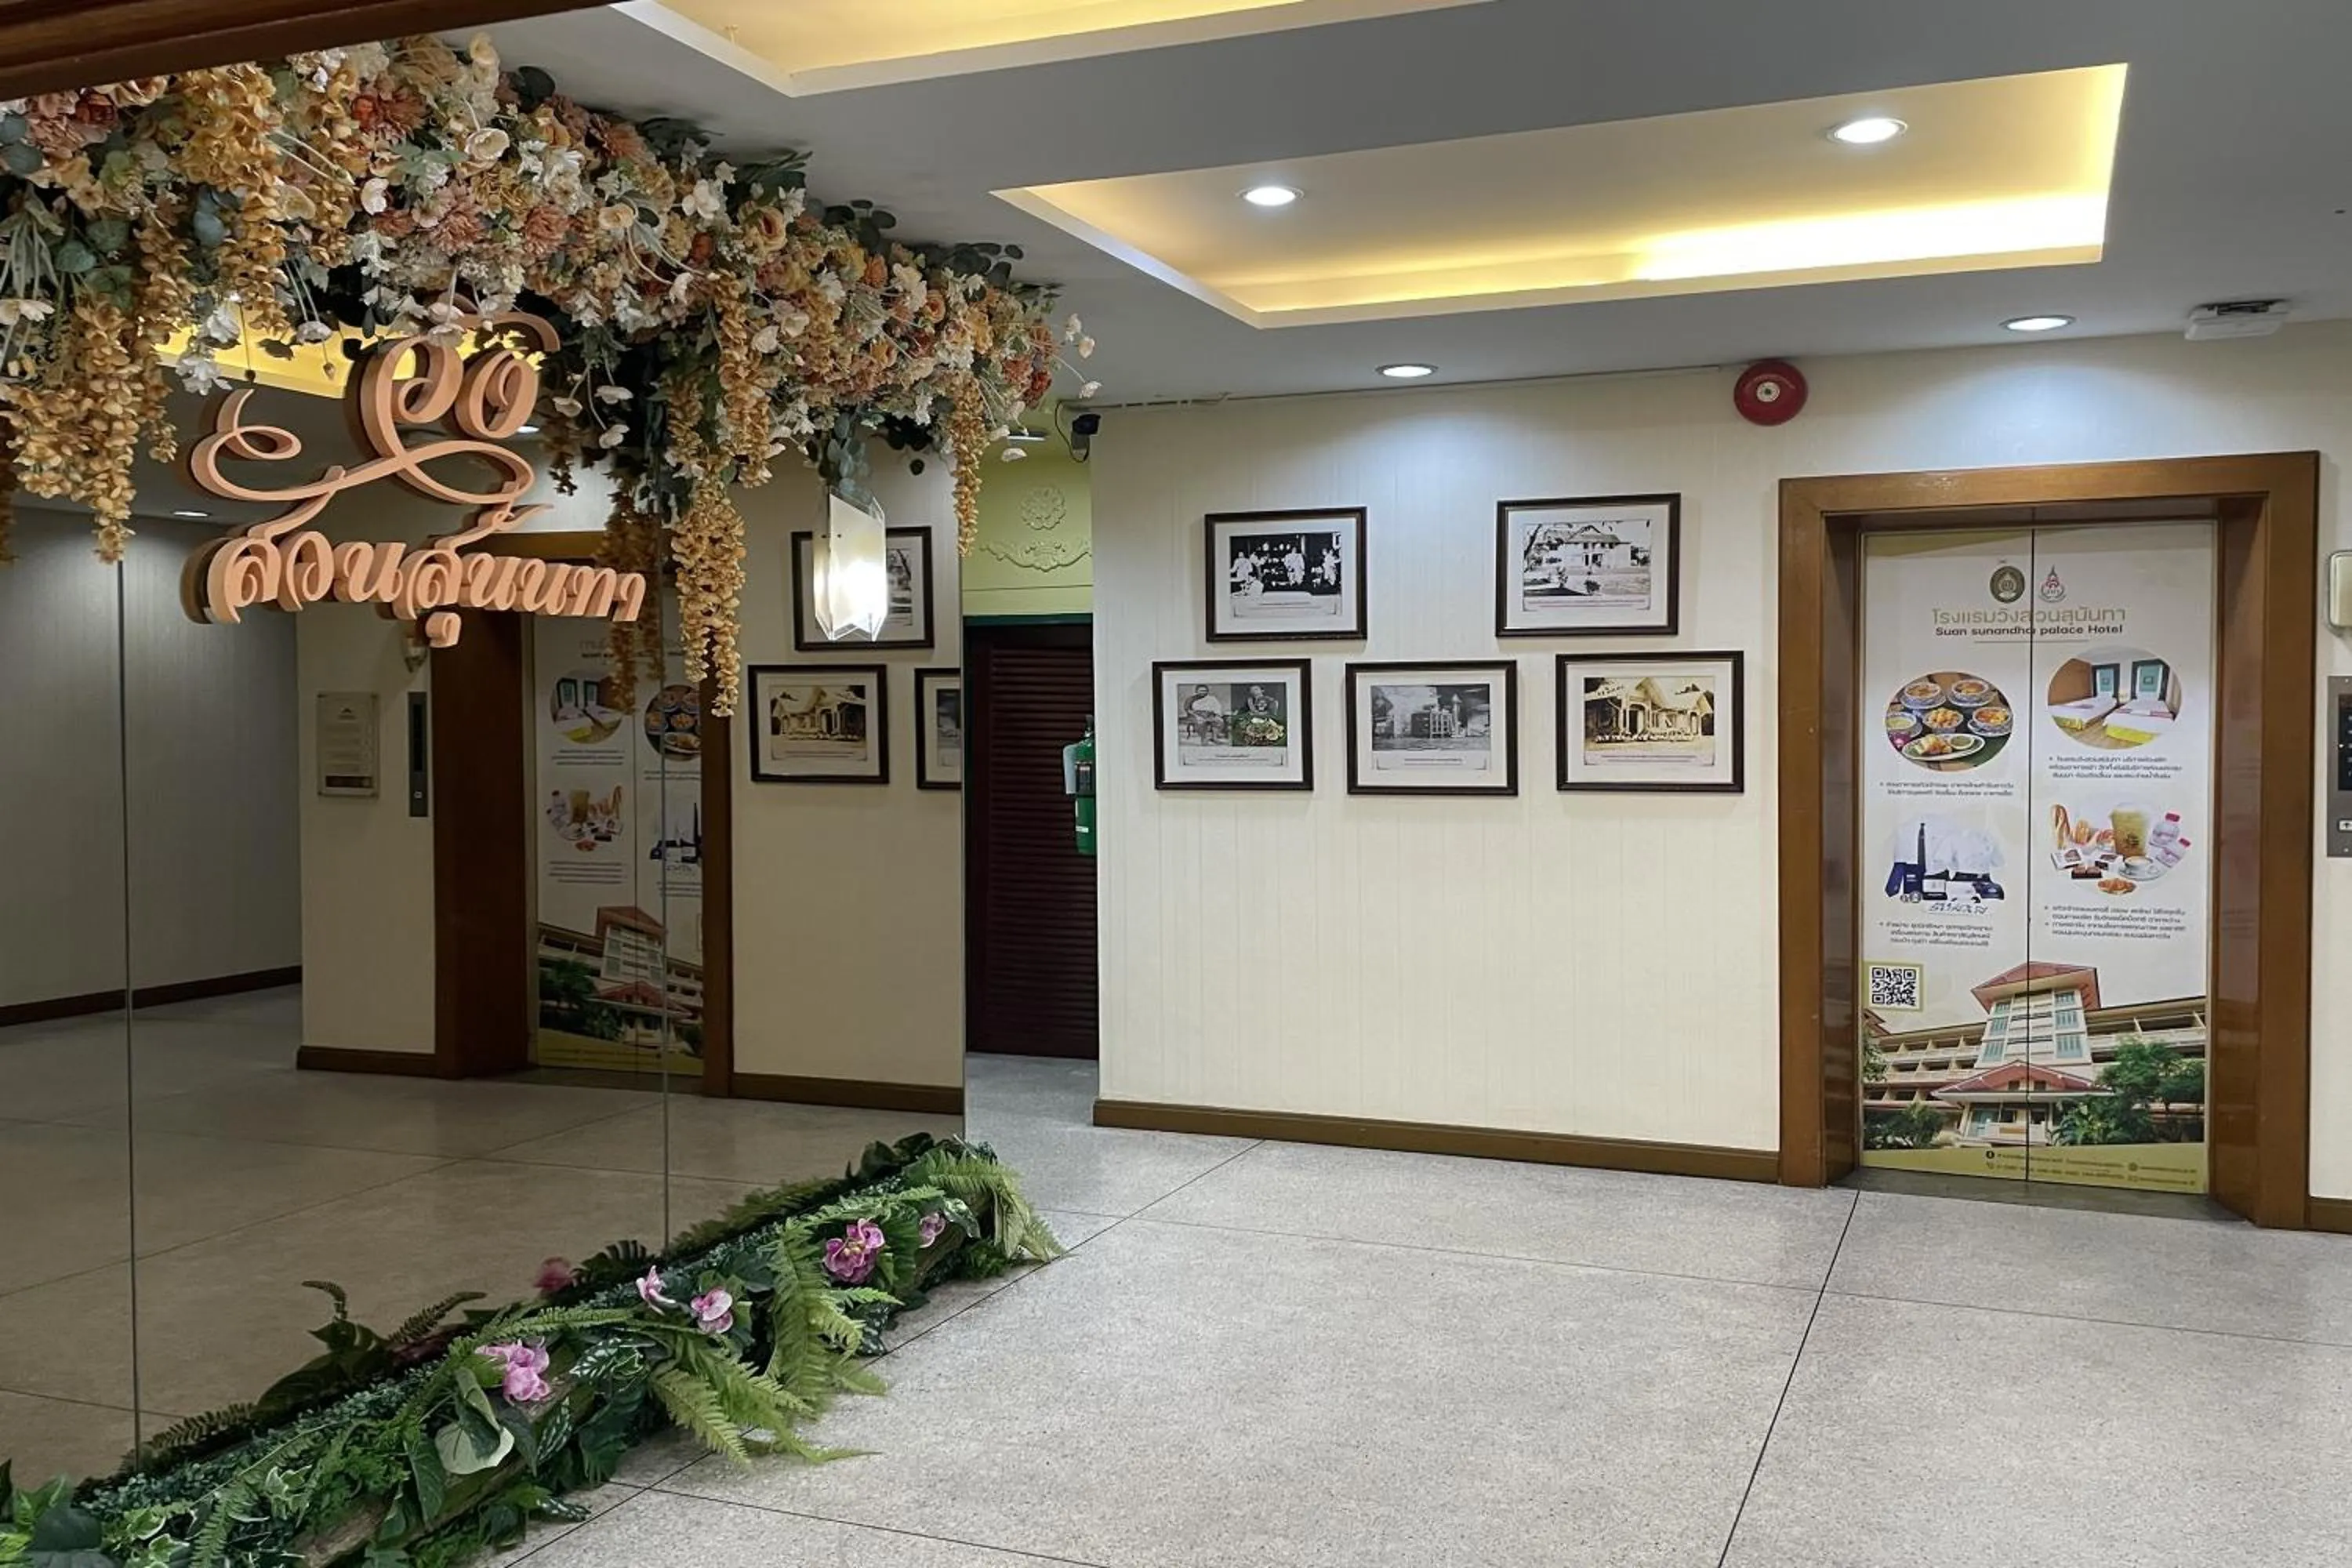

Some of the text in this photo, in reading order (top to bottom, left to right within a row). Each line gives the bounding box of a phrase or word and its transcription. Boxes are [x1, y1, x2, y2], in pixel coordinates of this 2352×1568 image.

[1932, 606, 2125, 626] โรงแรมวังสวนสุนันทา
[1936, 625, 2123, 636] Suan sunandha palace Hotel
